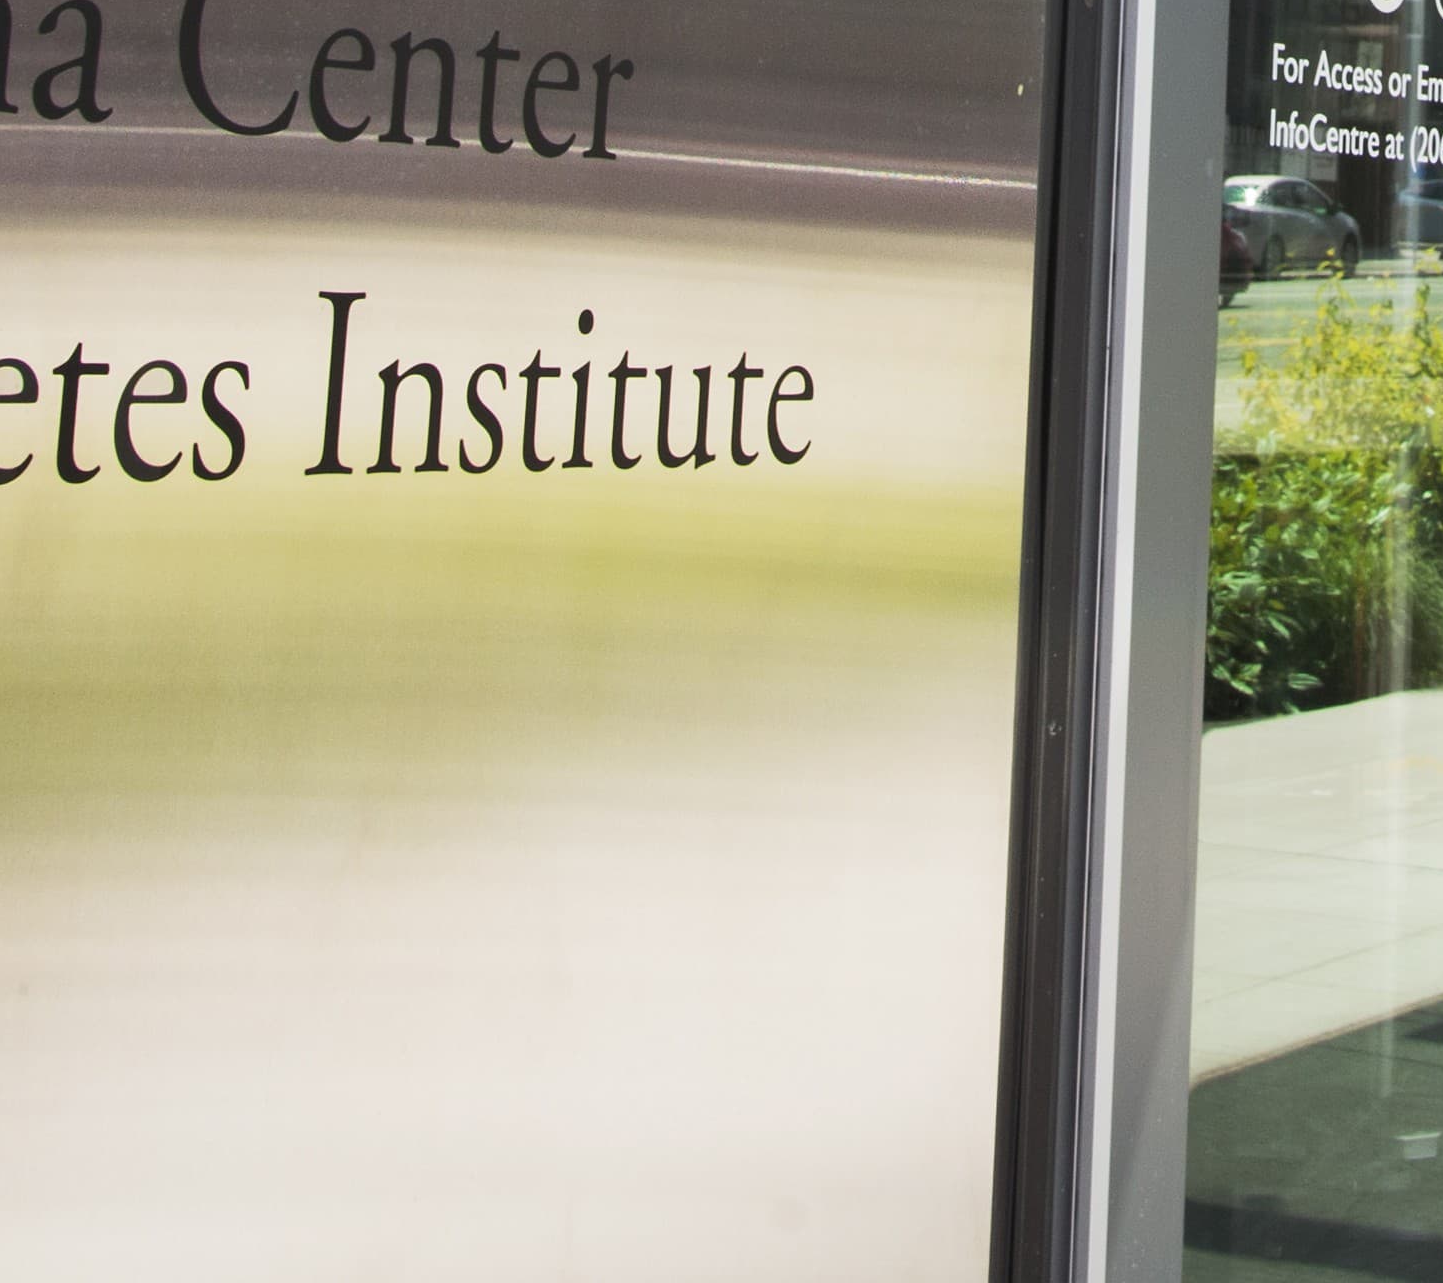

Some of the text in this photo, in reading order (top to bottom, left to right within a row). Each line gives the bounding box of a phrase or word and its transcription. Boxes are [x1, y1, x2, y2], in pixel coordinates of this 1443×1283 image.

[1271, 42, 1310, 85] For
[1313, 49, 1384, 95] Access
[1387, 71, 1412, 98] or
[1269, 107, 1380, 159] InfoCentre
[1384, 130, 1405, 161] at
[303, 290, 815, 477] Institute
